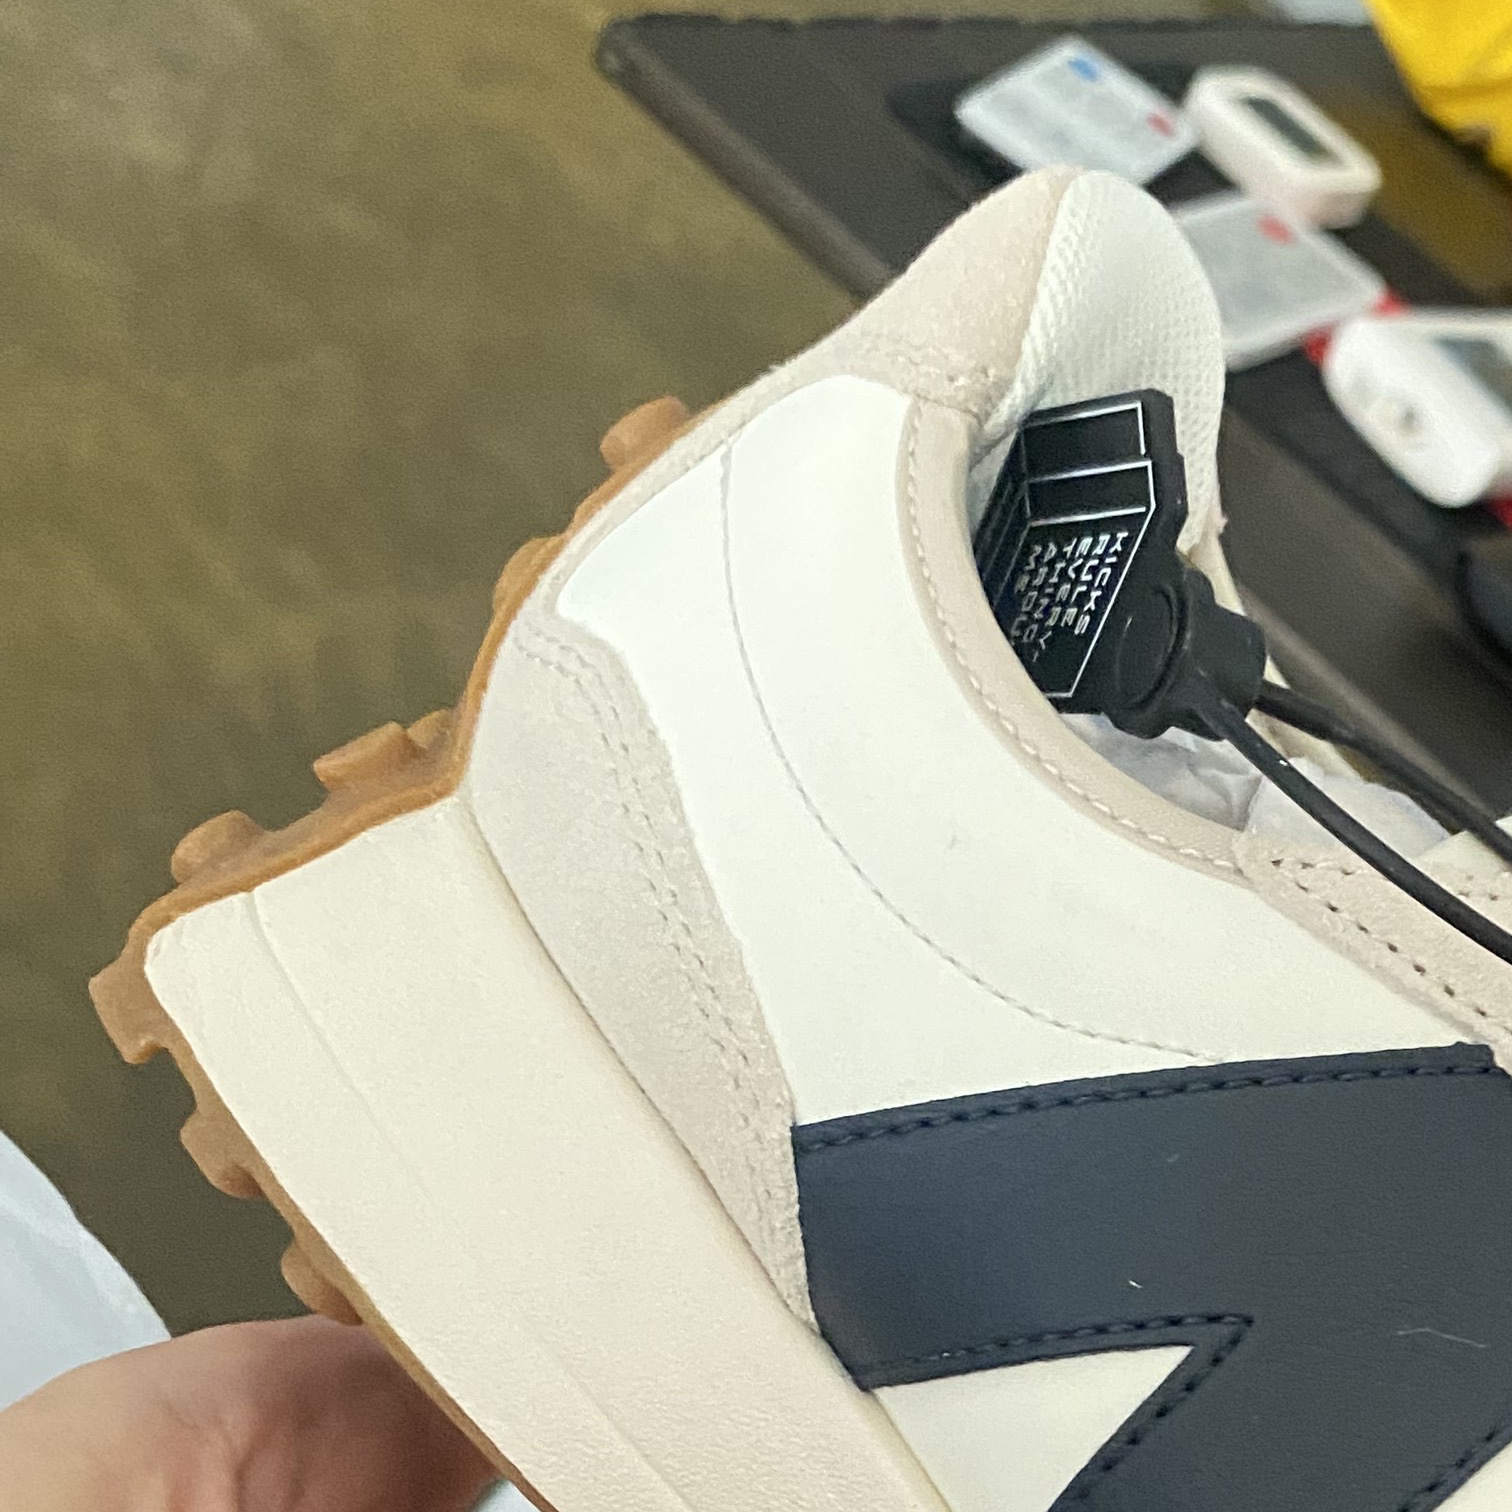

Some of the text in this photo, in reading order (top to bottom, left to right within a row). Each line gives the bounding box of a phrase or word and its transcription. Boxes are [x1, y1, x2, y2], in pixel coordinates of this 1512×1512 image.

[1010, 541, 1058, 646] AROU
[1014, 544, 1042, 594] ME
[1022, 537, 1078, 643] THING
[1060, 534, 1111, 627] RULE
[1074, 531, 1129, 636] KICKS
